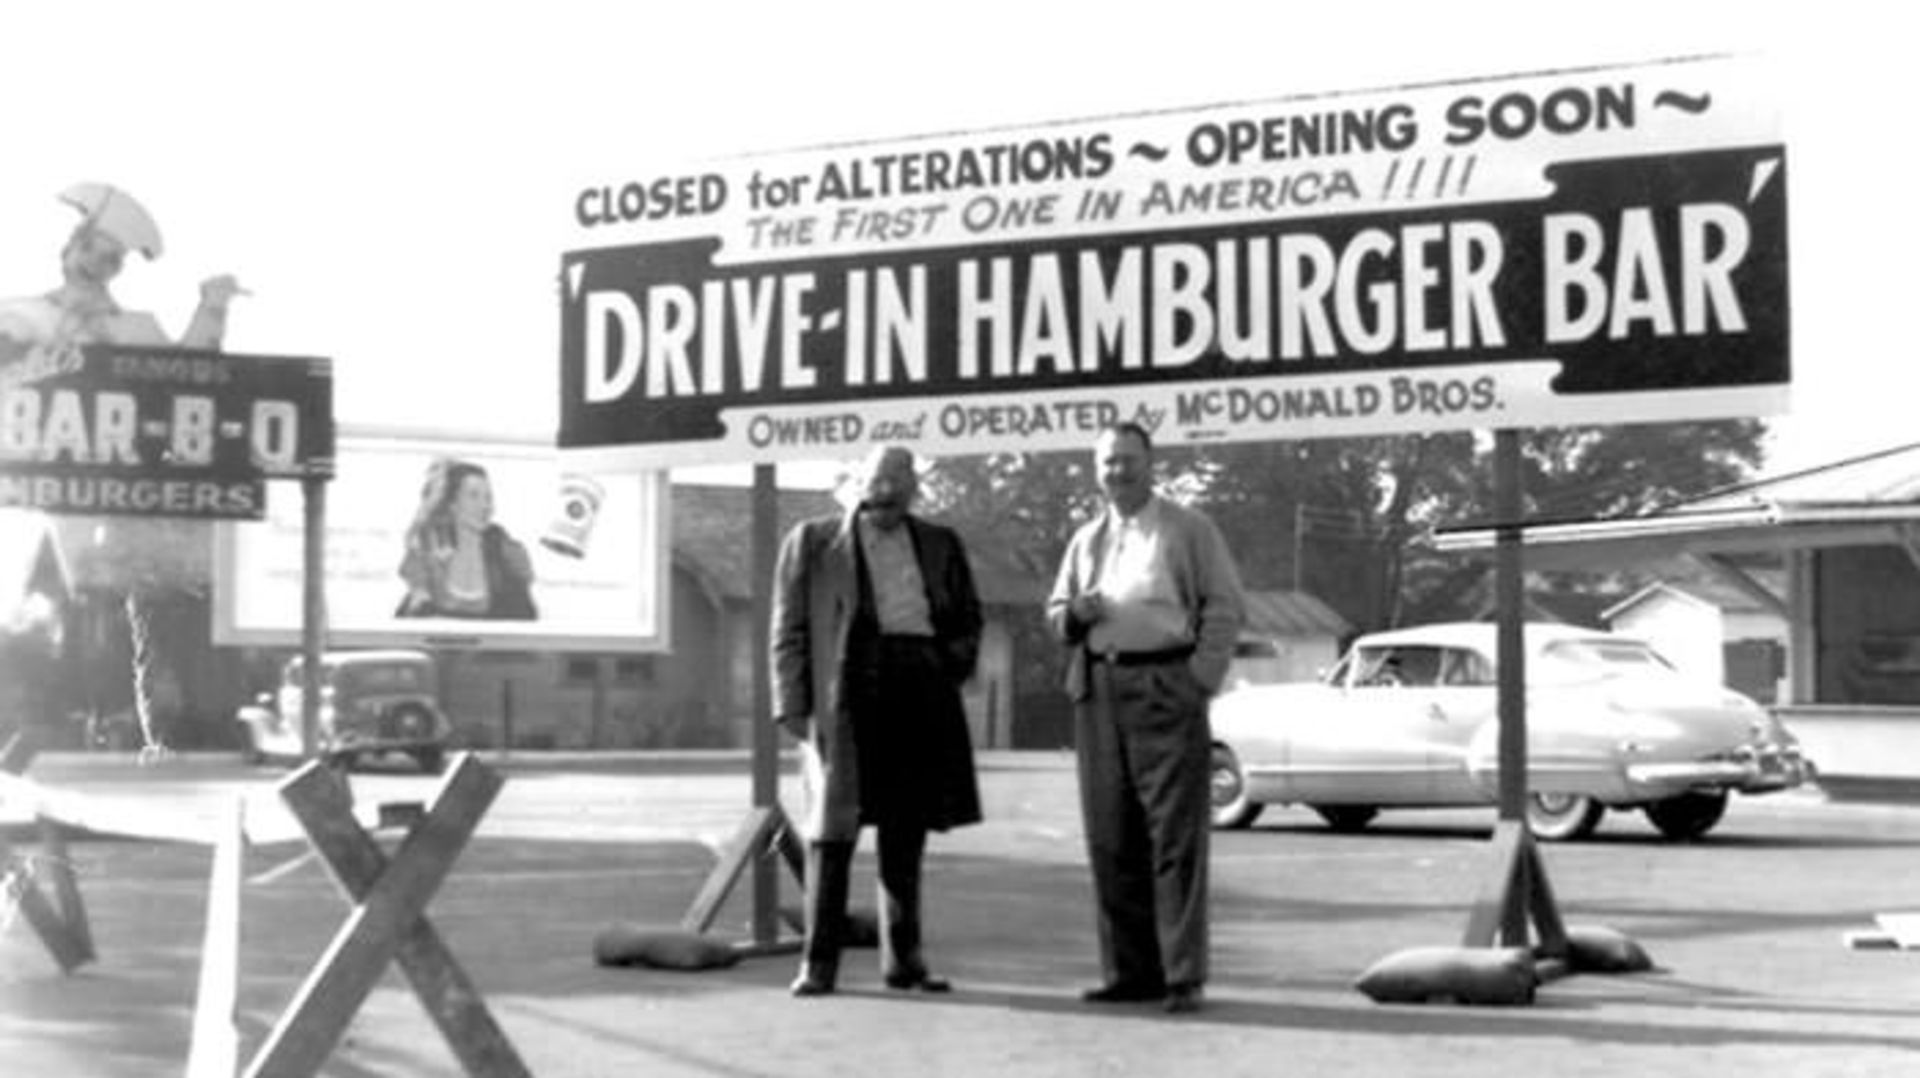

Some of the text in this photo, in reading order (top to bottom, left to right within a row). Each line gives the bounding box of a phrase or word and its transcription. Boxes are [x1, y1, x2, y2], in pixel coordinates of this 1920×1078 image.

[574, 82, 1637, 228] CLOSED for ALTERATIONS OPENING SOON
[746, 214, 815, 250] THE
[831, 202, 950, 244] FIRST
[959, 193, 1060, 235] ONE
[1074, 187, 1124, 222] IN
[1138, 169, 1362, 216] AMERICA
[957, 220, 1506, 379] HAMBURGER
[747, 412, 865, 449] OWNED
[869, 411, 926, 442] and
[938, 400, 1121, 439] OPERATED
[1387, 374, 1507, 417] BROS.
